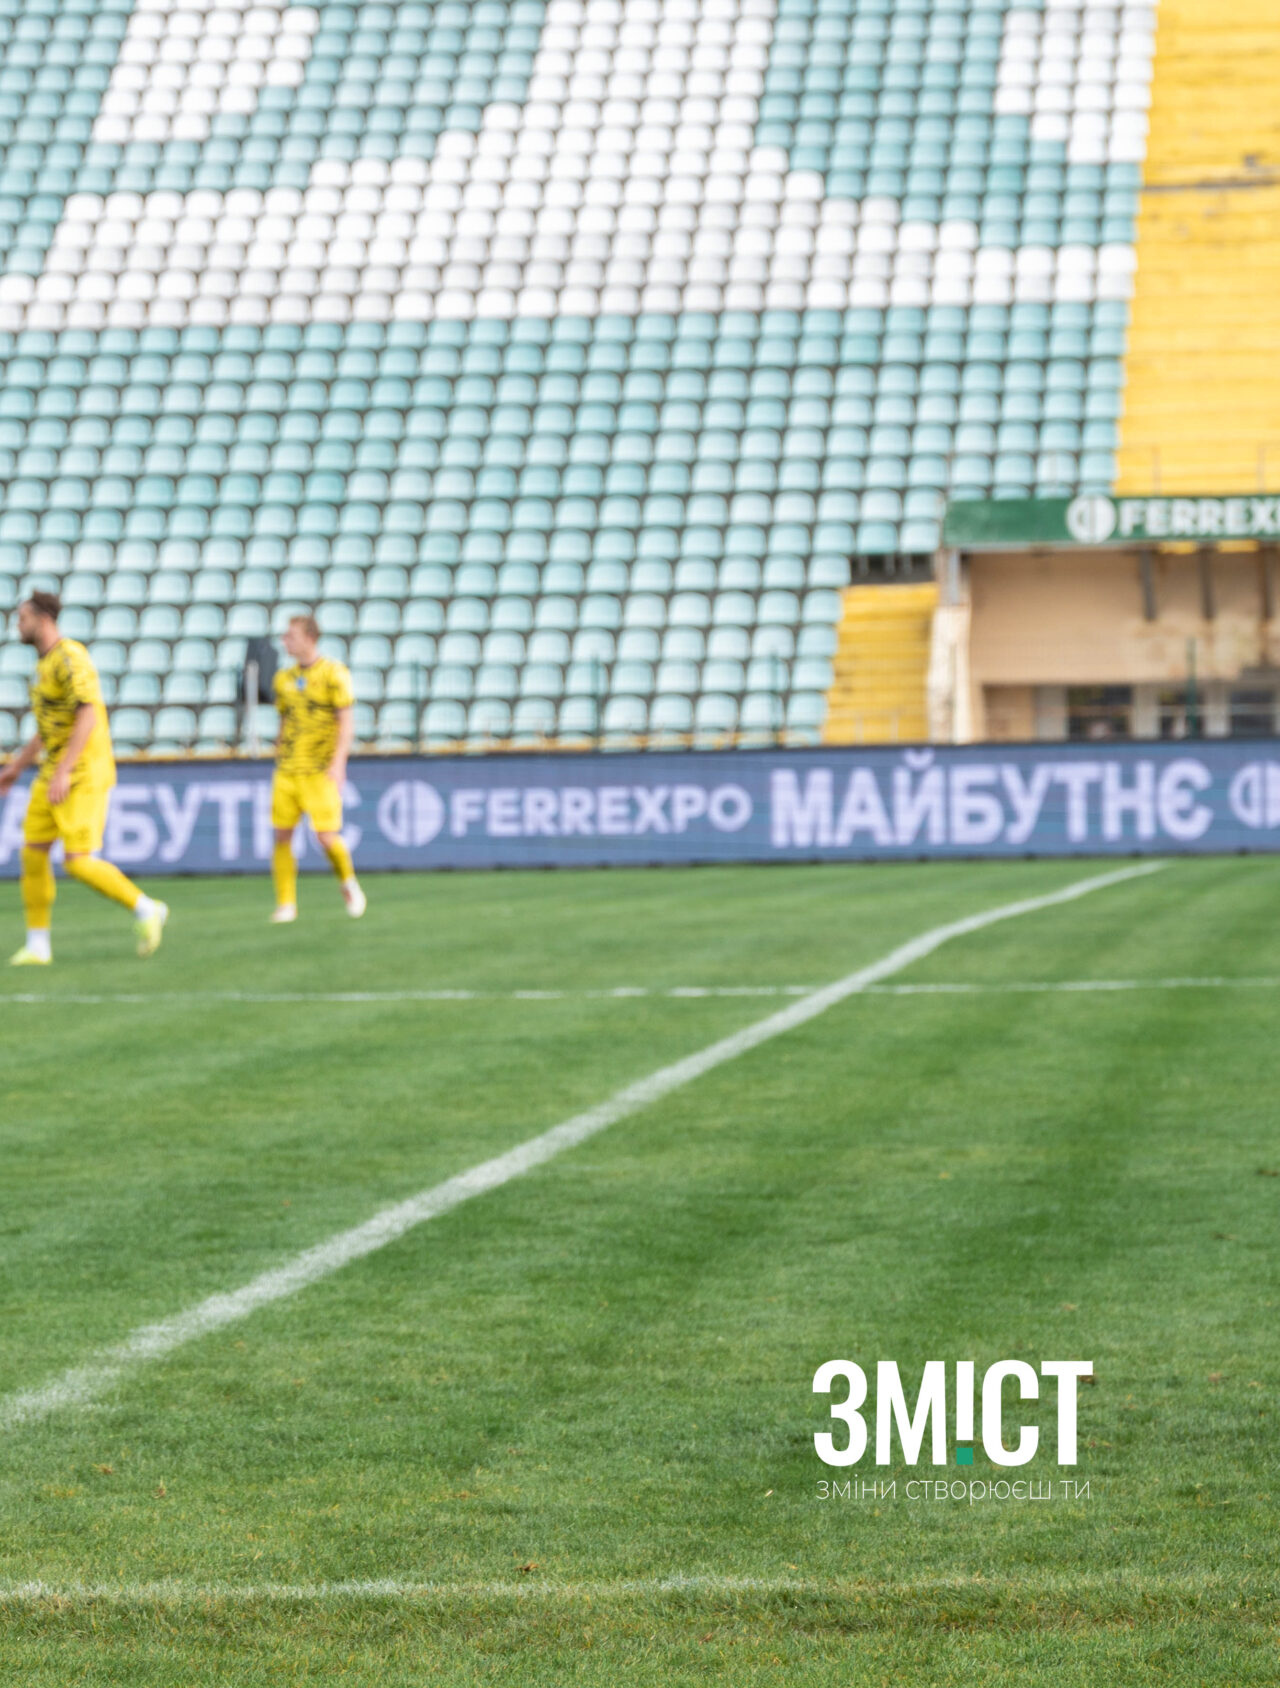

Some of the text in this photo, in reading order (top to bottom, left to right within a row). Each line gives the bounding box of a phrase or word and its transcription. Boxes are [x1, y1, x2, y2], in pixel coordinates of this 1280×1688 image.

[1120, 498, 1280, 537] FERREX
[450, 783, 753, 838] FERREXPO
[769, 747, 1213, 848] МАЙБУТНЄ
